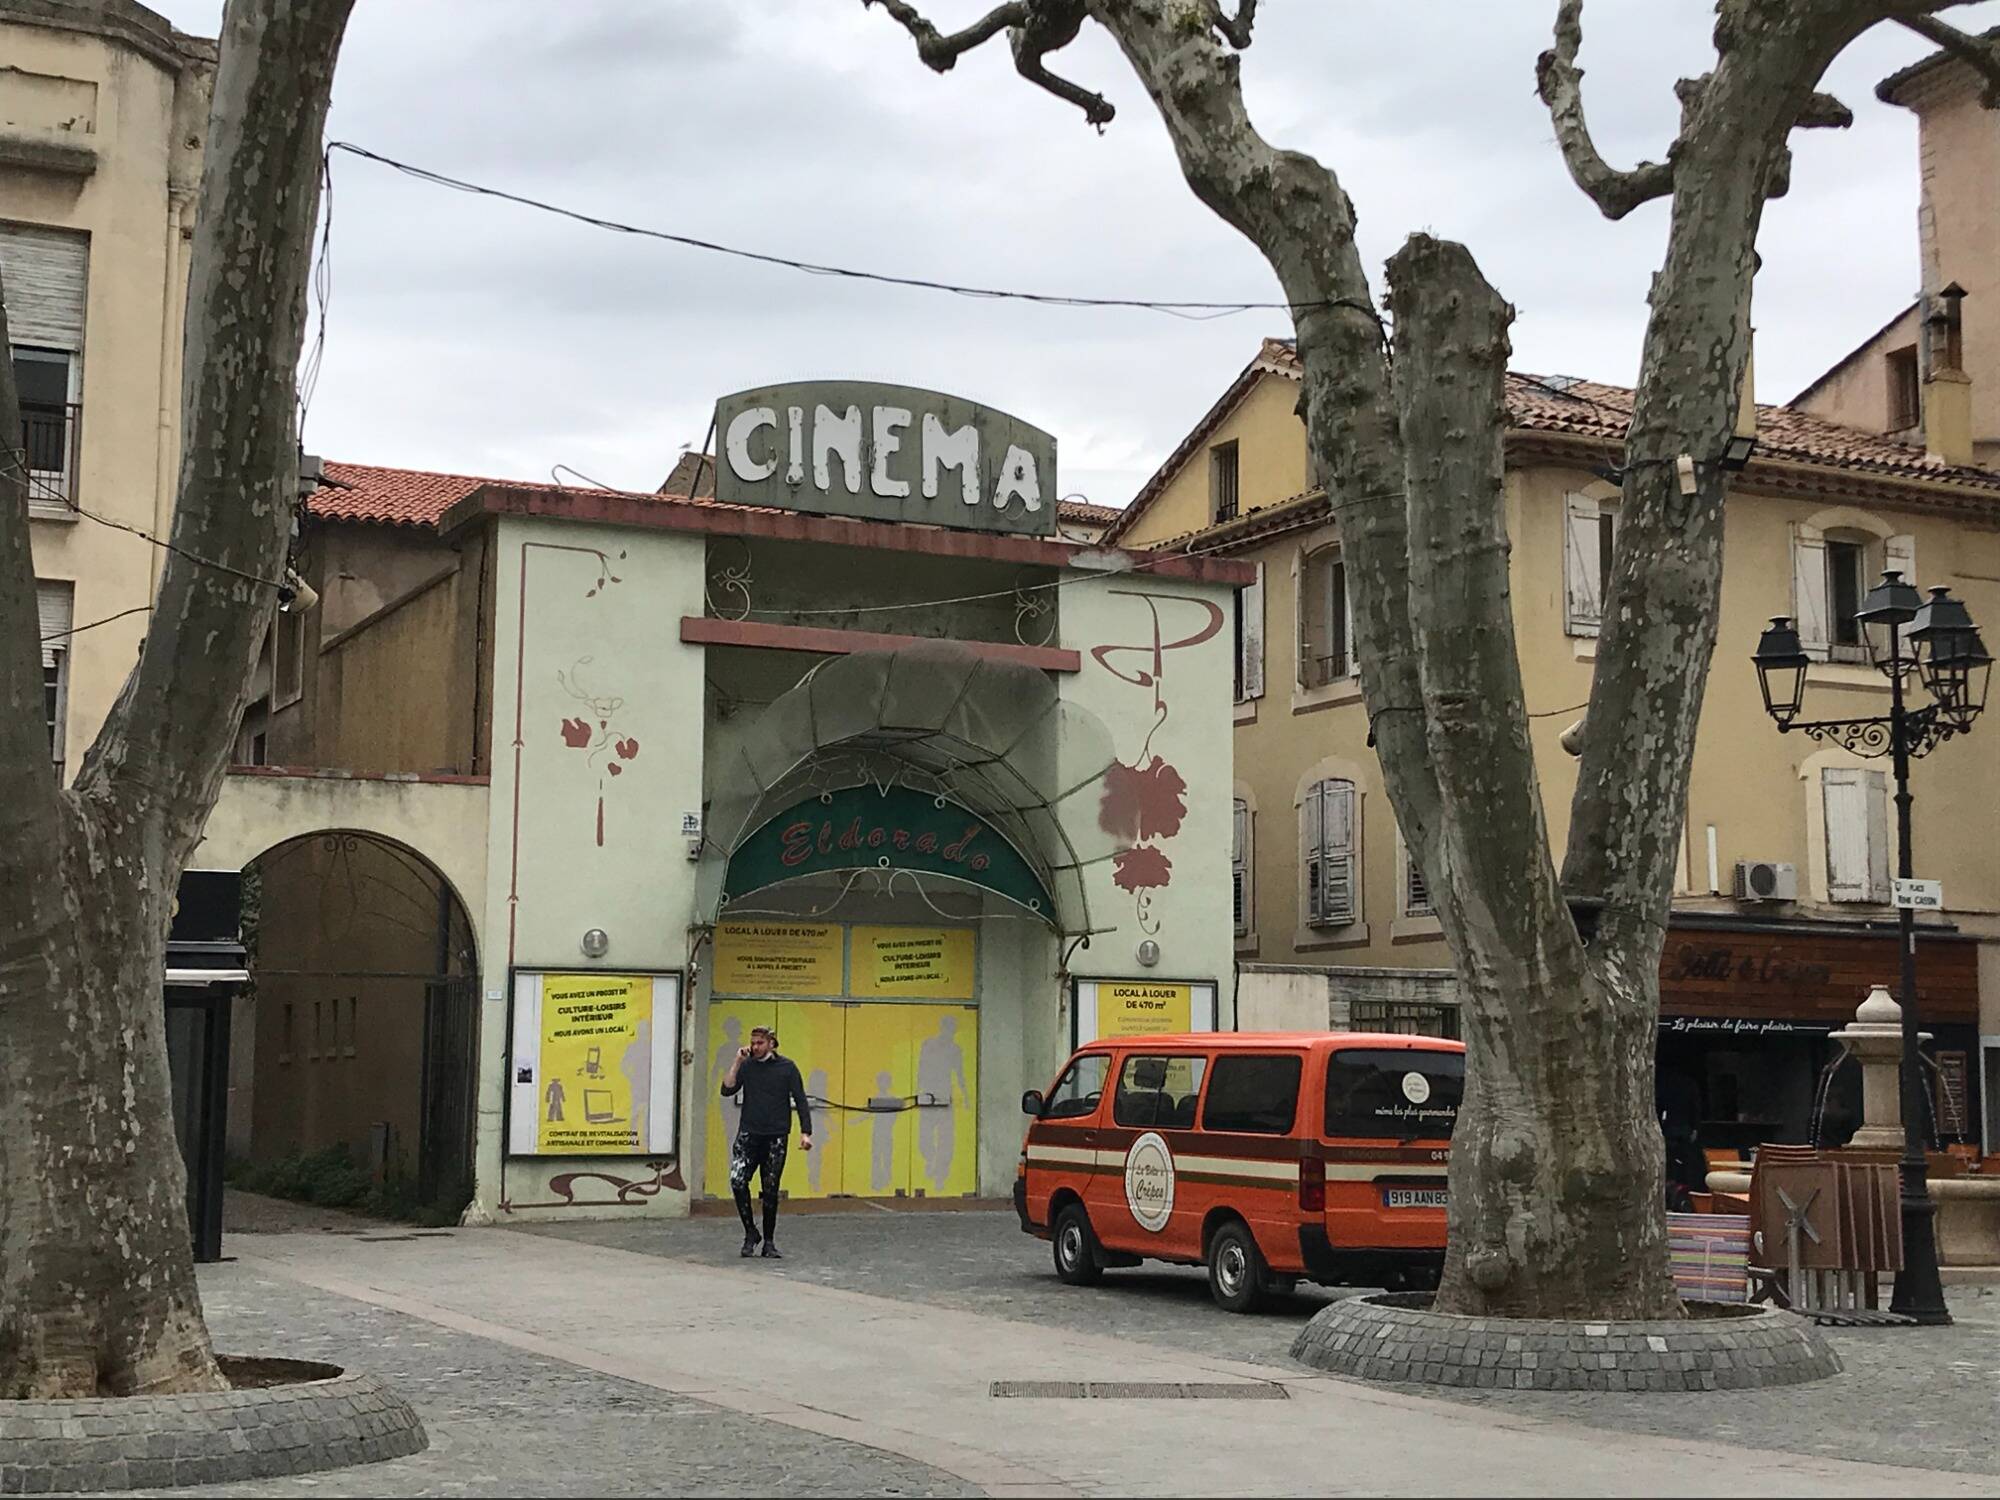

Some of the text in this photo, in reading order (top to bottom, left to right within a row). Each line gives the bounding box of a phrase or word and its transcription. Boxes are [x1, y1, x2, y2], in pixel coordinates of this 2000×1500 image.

[726, 403, 1041, 512] CINEMA
[780, 816, 991, 870] Eldorado
[724, 927, 751, 935] LOCAL
[761, 928, 788, 937] LOUER
[789, 928, 801, 937] DE
[801, 928, 816, 937] 470
[551, 992, 568, 1000] VOUS
[569, 991, 585, 999] AVEZ
[586, 990, 595, 998] UN
[619, 988, 628, 996] DE
[1114, 987, 1177, 999] LOCAL À LOUER
[557, 1002, 627, 1014] CULTURE-LOISIRS
[1126, 1001, 1138, 1009] DE
[1138, 1001, 1154, 1010] 470
[554, 1029, 572, 1037] NOUS
[572, 1028, 594, 1036] AVONS
[595, 1027, 604, 1035] UN
[605, 1025, 625, 1033] LOCAL
[1672, 1017, 1794, 1035] Le plaisir de faire plaisir
[1393, 1104, 1403, 1116] les
[1403, 1104, 1418, 1120] plus
[1431, 1151, 1443, 1160] 04
[1135, 1179, 1164, 1201] Crêpes
[1391, 1192, 1448, 1204] 919 AAN 83
